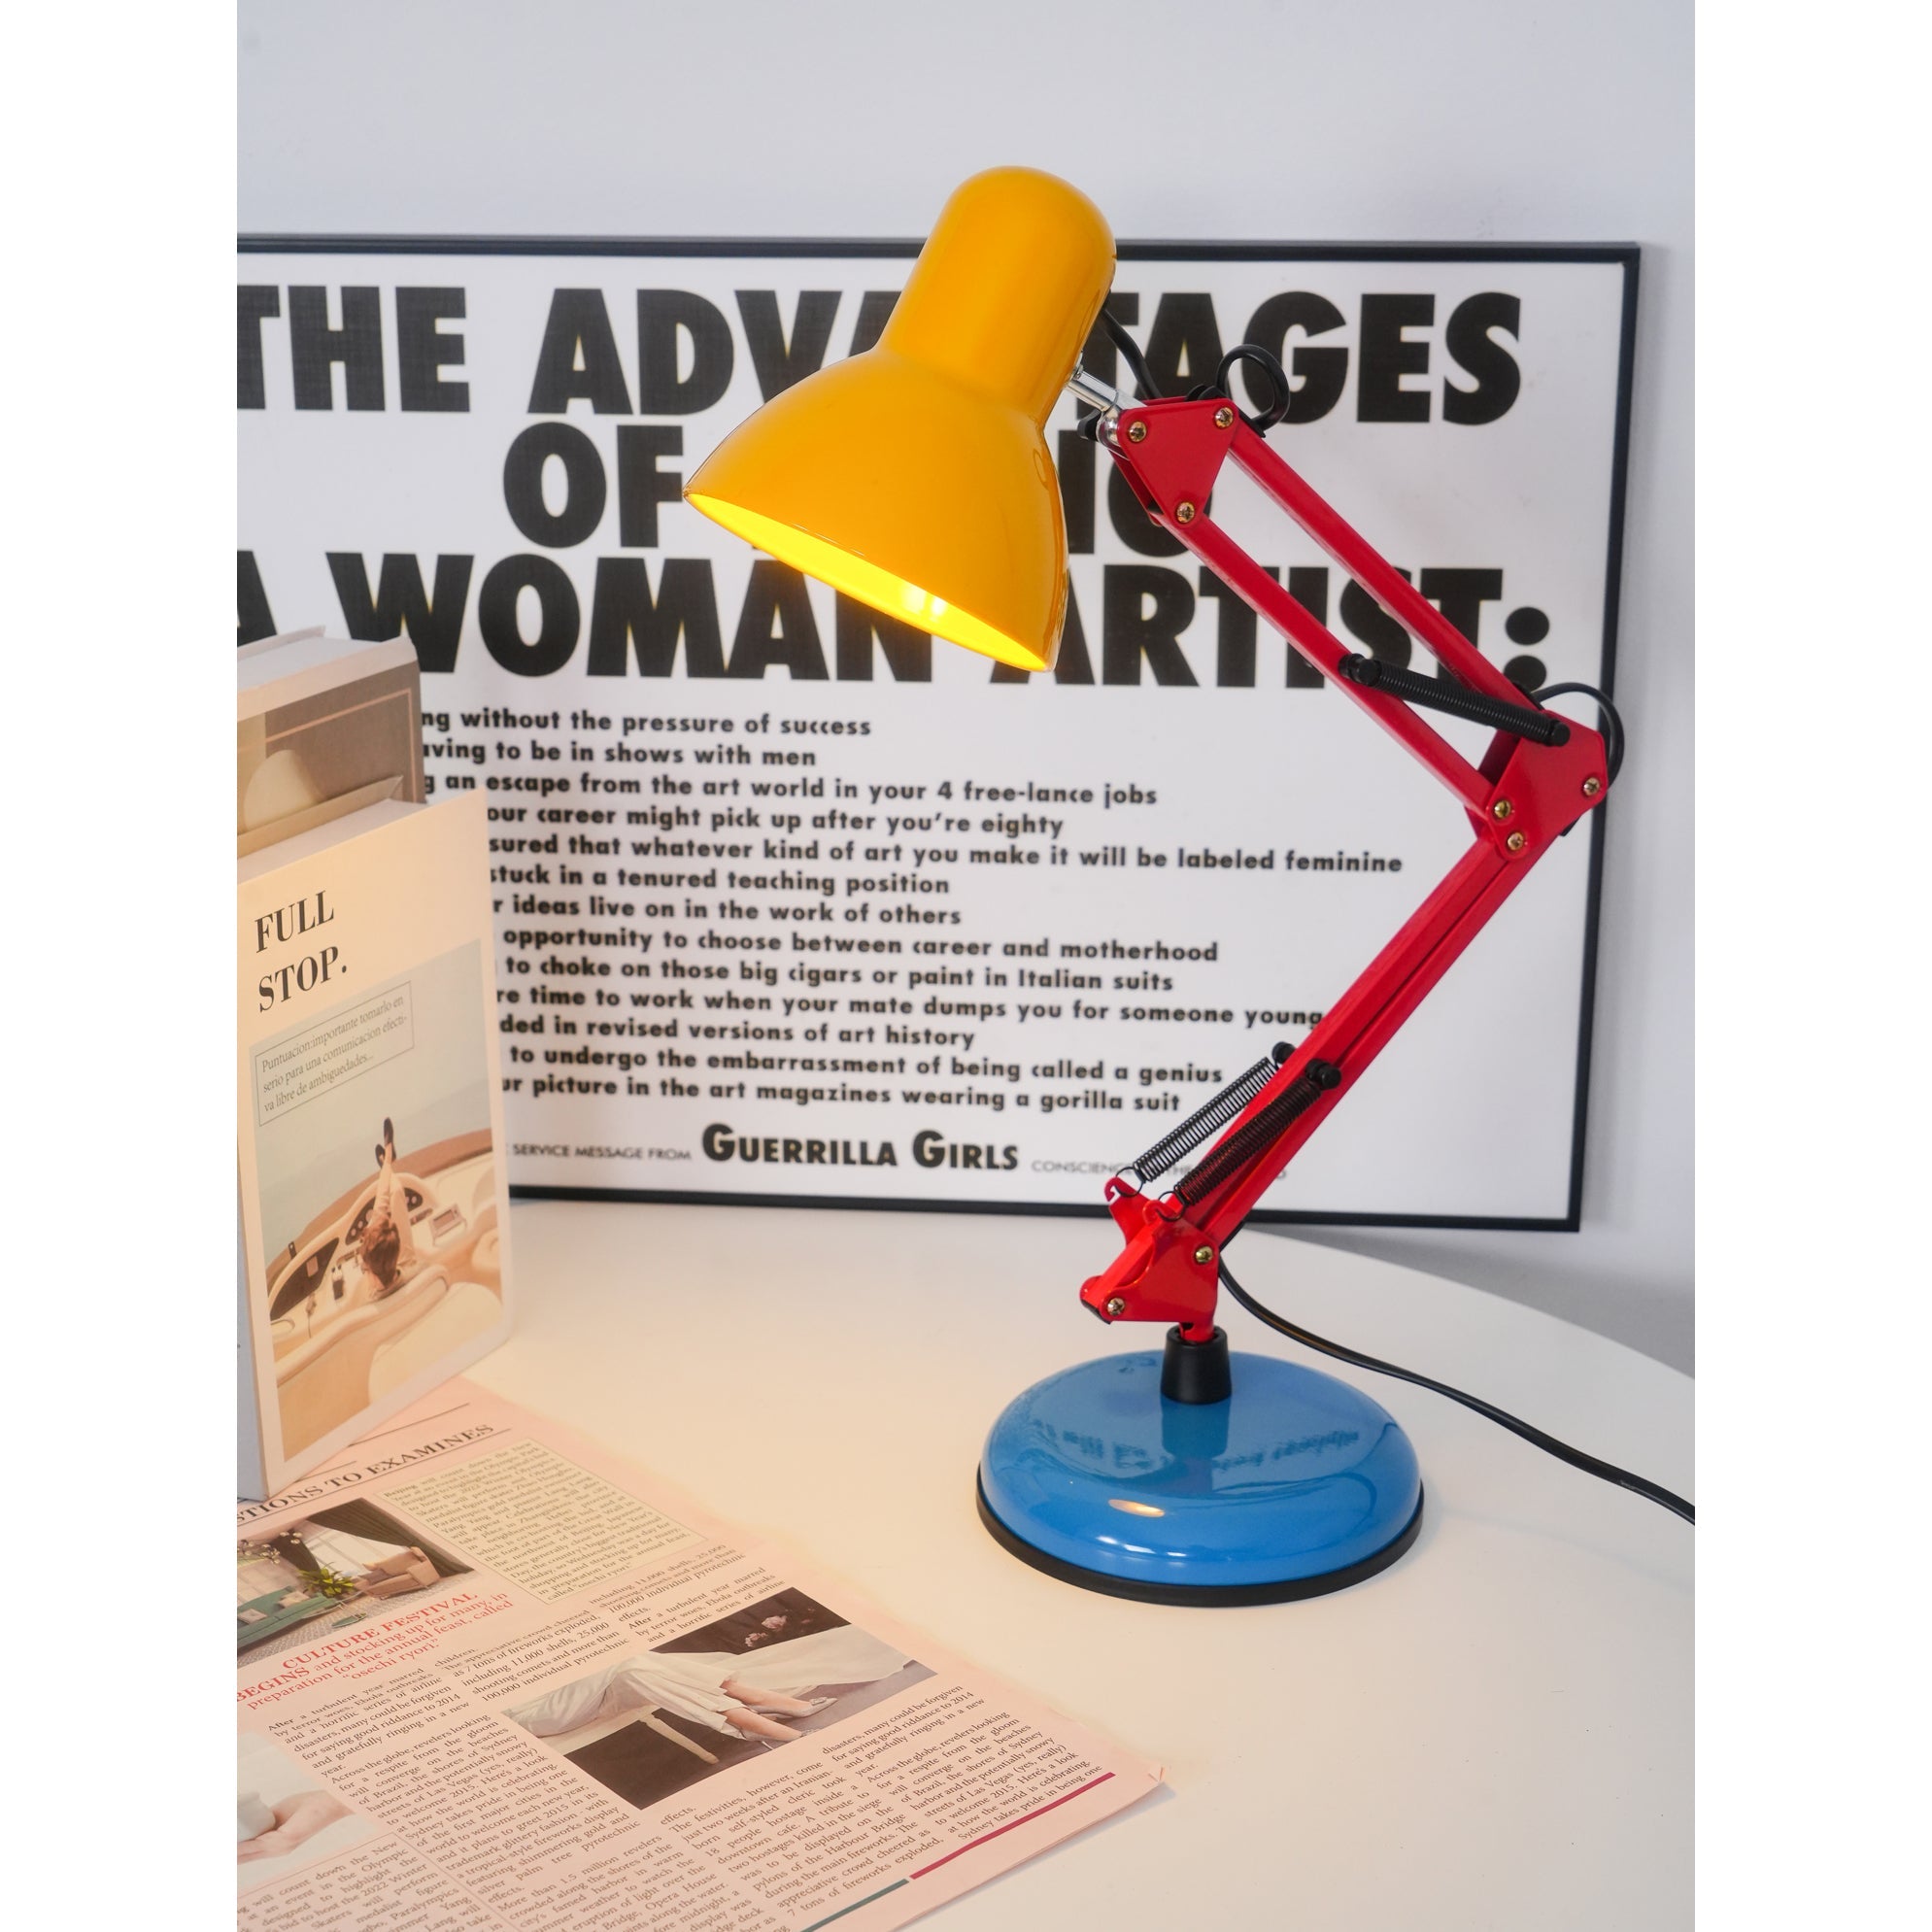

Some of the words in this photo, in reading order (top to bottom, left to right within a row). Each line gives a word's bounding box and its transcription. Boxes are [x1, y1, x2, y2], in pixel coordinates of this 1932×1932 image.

[237, 285, 471, 413] THE
[503, 421, 683, 548] OF
[459, 706, 560, 729] without
[570, 708, 612, 731] the
[622, 717, 734, 737] pressure
[744, 712, 770, 734] of
[780, 720, 871, 736] success
[494, 741, 522, 761] to
[530, 739, 561, 762] be
[570, 740, 594, 763] in
[604, 741, 684, 764] shows
[694, 743, 752, 765] with
[762, 751, 816, 766] men
[445, 775, 477, 791] an
[485, 775, 571, 798] escape
[579, 771, 641, 795] from
[651, 773, 693, 796] the
[702, 778, 740, 797] art
[750, 776, 825, 798] world
[834, 777, 859, 798] in
[868, 785, 927, 805] your
[936, 780, 953, 800] 4
[963, 780, 1094, 803] free-lance
[1104, 783, 1158, 810] jobs
[487, 806, 527, 823] our
[536, 808, 617, 825] career
[626, 804, 701, 832] might
[710, 806, 761, 832] pick
[770, 814, 801, 834] up
[811, 808, 876, 830] after
[980, 812, 1064, 840] eighty
[488, 832, 559, 855] sured
[567, 833, 622, 856] that
[630, 835, 754, 859] whatever
[763, 838, 820, 861] kind
[829, 840, 855, 861] of
[864, 844, 902, 862] art
[912, 848, 959, 868] you
[969, 843, 1040, 865] make
[1050, 844, 1068, 865] it
[1078, 845, 1127, 867] will
[1136, 846, 1168, 868] be
[1177, 847, 1274, 870] labeled
[1284, 849, 1403, 873] feminine
[490, 863, 551, 885] stuck
[559, 864, 584, 886] in
[592, 871, 608, 886] a
[617, 867, 717, 889] tenured
[727, 869, 835, 898] teaching
[846, 872, 949, 898] position
[254, 890, 334, 954] FULL
[512, 893, 581, 916] ideas
[589, 895, 635, 917] live
[644, 903, 675, 918] on
[685, 898, 708, 919] in
[718, 898, 760, 920] the
[768, 901, 833, 922] work
[843, 902, 869, 923] of
[878, 903, 962, 925] others
[502, 927, 653, 954] opportunity
[662, 931, 689, 949] to
[697, 929, 782, 951] choose
[792, 931, 902, 954] between
[912, 940, 992, 956] career
[1001, 937, 1049, 958] and
[1060, 938, 1218, 962] motherhood
[258, 946, 347, 1013] STOP.
[505, 956, 531, 975] to
[539, 954, 612, 977] choke
[620, 963, 651, 978] on
[661, 958, 730, 980] those
[739, 960, 778, 987] big
[788, 962, 863, 988] cigars
[871, 970, 898, 984] or
[908, 965, 974, 991] paint
[985, 966, 1008, 987] in
[1018, 968, 1102, 990] Italian
[1113, 970, 1173, 992] suits
[359, 1000, 391, 1024] tomarlo
[392, 996, 404, 1008] en
[495, 989, 521, 1004] re
[529, 984, 587, 1006] time
[594, 988, 621, 1007] to
[629, 988, 694, 1009] work
[703, 990, 772, 1011] when
[782, 998, 839, 1017] your
[849, 997, 913, 1015] mate
[923, 995, 1006, 1022] dumps
[1017, 1004, 1063, 1023] you
[1072, 999, 1109, 1020] for
[1120, 1006, 1235, 1024] someone
[1245, 1010, 1322, 1030] young
[554, 1014, 578, 1035] in
[586, 1017, 679, 1038] revised
[688, 1020, 794, 1041] versions
[803, 1022, 829, 1042] of
[838, 1027, 875, 1043] art
[885, 1024, 975, 1052] history
[263, 1074, 284, 1093] serio
[286, 1066, 304, 1086] para
[305, 1056, 322, 1070] una
[322, 1027, 382, 1063] comunicacion
[509, 1045, 535, 1064] to
[543, 1044, 648, 1072] undergo
[657, 1047, 697, 1068] the
[706, 1050, 906, 1074] embarrassment
[916, 1055, 941, 1075] of
[951, 1056, 1021, 1083] being
[1031, 1059, 1104, 1080] called
[1114, 1067, 1129, 1080] a
[1138, 1062, 1223, 1087] genius
[263, 1102, 275, 1112] va
[276, 1088, 295, 1107] libre
[296, 1081, 308, 1097] de
[532, 1073, 618, 1099] picture
[627, 1075, 650, 1097] in
[660, 1077, 700, 1098] the
[708, 1081, 746, 1099] art
[756, 1082, 892, 1106] magazines
[901, 1086, 1005, 1112] wearing
[1015, 1094, 1030, 1107] a
[1039, 1089, 1123, 1113] gorilla
[1134, 1092, 1180, 1112] suit
[513, 1143, 570, 1158] SERVICE
[574, 1145, 644, 1160] MESSAGE
[648, 1149, 692, 1161] FROM
[701, 1122, 898, 1168] GUERRILLA
[911, 1129, 1019, 1171] GIRLS
[324, 1472, 362, 1489] TO
[366, 1424, 494, 1474] EXAMINES
[283, 1627, 380, 1670] CULTURE
[381, 1592, 478, 1632] FESTIVAL
[314, 1654, 342, 1672] and
[343, 1631, 412, 1663] stocking
[408, 1623, 424, 1639] up
[424, 1613, 447, 1629] for
[449, 1599, 492, 1617] many,
[491, 1592, 508, 1603] in
[247, 1672, 333, 1711] preparation
[335, 1661, 357, 1678] for
[357, 1651, 383, 1667] the
[385, 1630, 433, 1655] annual
[433, 1618, 473, 1636] feast,
[473, 1598, 514, 1619] called
[482, 1681, 521, 1703] 100,000
[522, 1660, 572, 1686] individual
[573, 1638, 629, 1666] pyrotechnic
[822, 1733, 865, 1754] disasters,
[864, 1720, 891, 1737] many
[889, 1705, 916, 1723] could
[914, 1701, 926, 1712] be
[923, 1684, 964, 1707] forgiven
[668, 1820, 693, 1834] The
[694, 1796, 747, 1822] festivities,
[746, 1774, 795, 1798] however,
[796, 1761, 824, 1776] come
